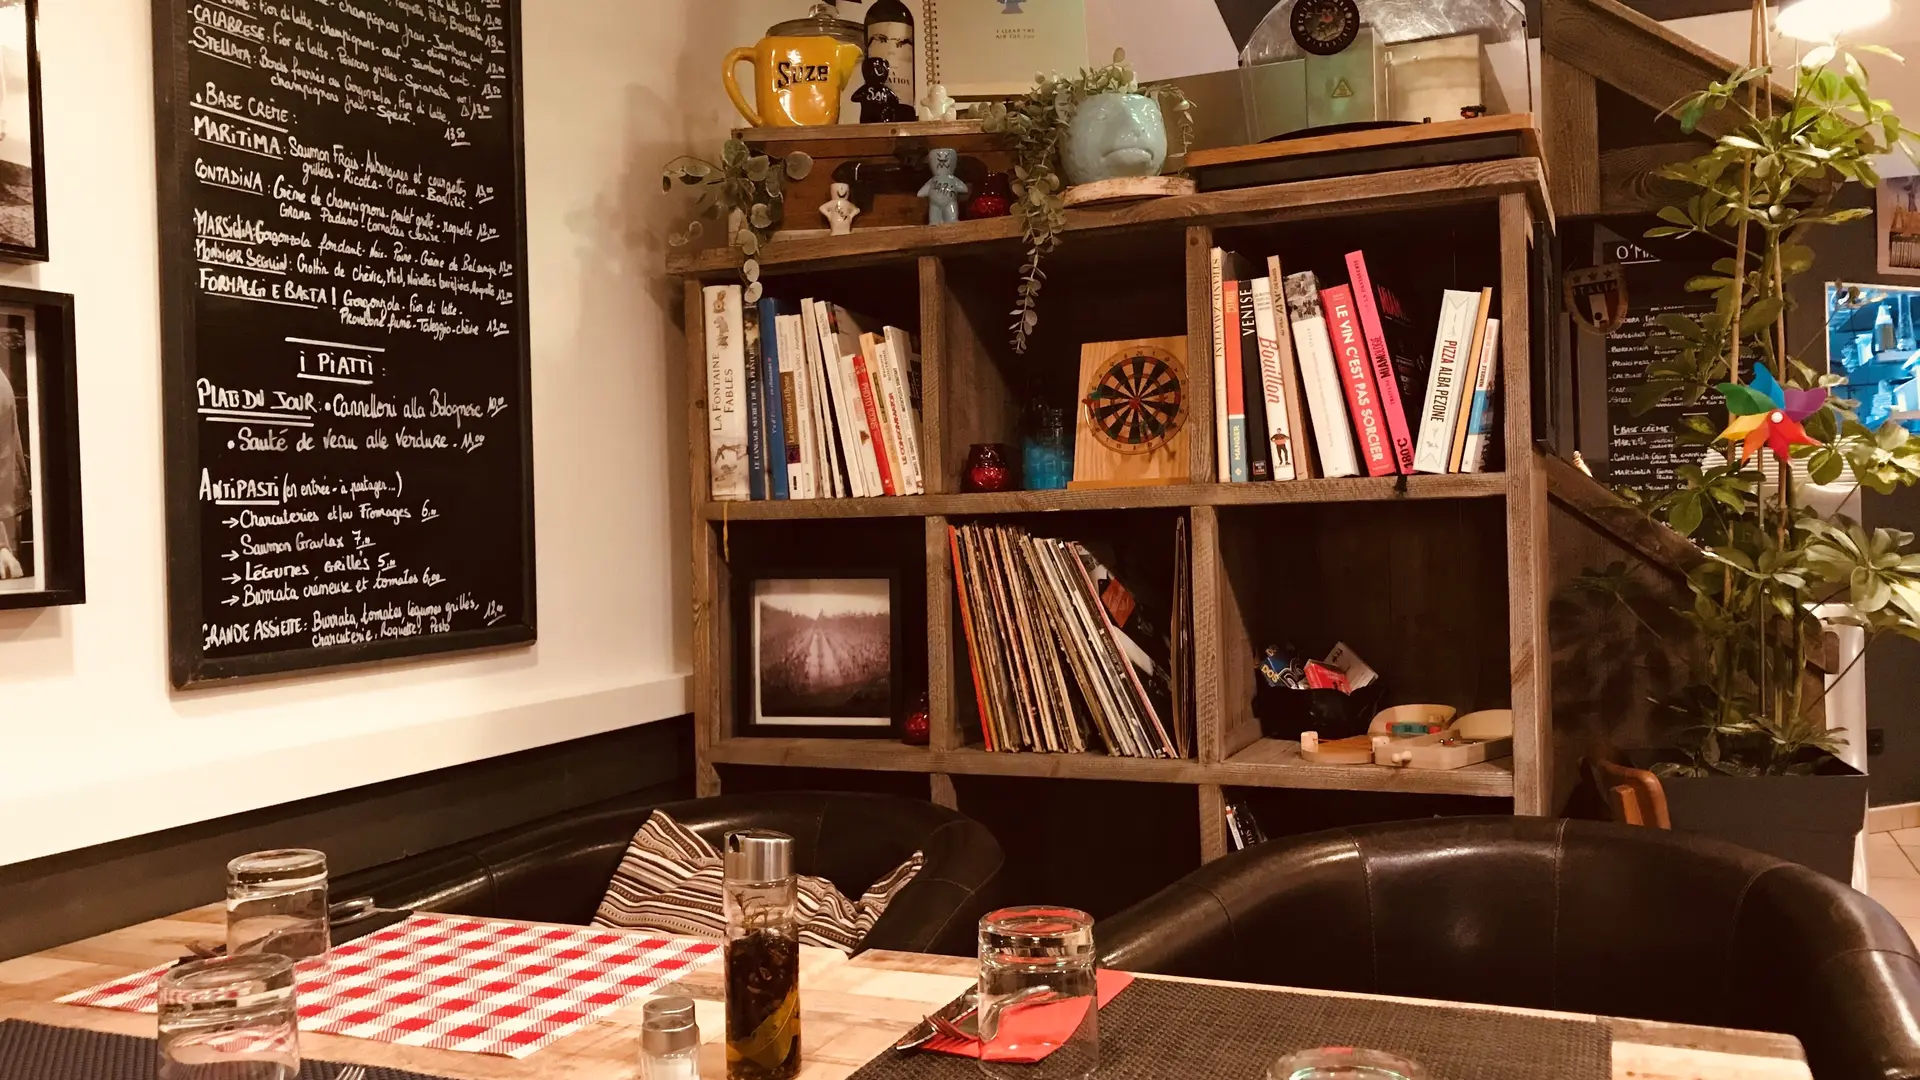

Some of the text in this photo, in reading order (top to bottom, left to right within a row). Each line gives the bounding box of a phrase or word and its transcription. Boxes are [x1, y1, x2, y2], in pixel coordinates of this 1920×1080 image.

[777, 62, 829, 88] Suze
[205, 81, 243, 110] BASE
[1239, 288, 1255, 337] VENISE
[1258, 335, 1284, 405] Bouillon
[1335, 304, 1385, 462] LE VIN C'EST PAS SORCIER
[1430, 339, 1458, 423] PIZZA ALBA PEZONE
[333, 392, 398, 419] Cannelloni
[711, 352, 722, 432] LA FONTAINE
[723, 368, 734, 413] FABLES
[237, 426, 289, 452] Sauté
[296, 431, 316, 452] de
[239, 507, 320, 529] Charcuteries
[358, 502, 412, 526] Fromages
[239, 533, 293, 556] Saumon
[242, 583, 300, 608] Burrata
[355, 576, 370, 593] et
